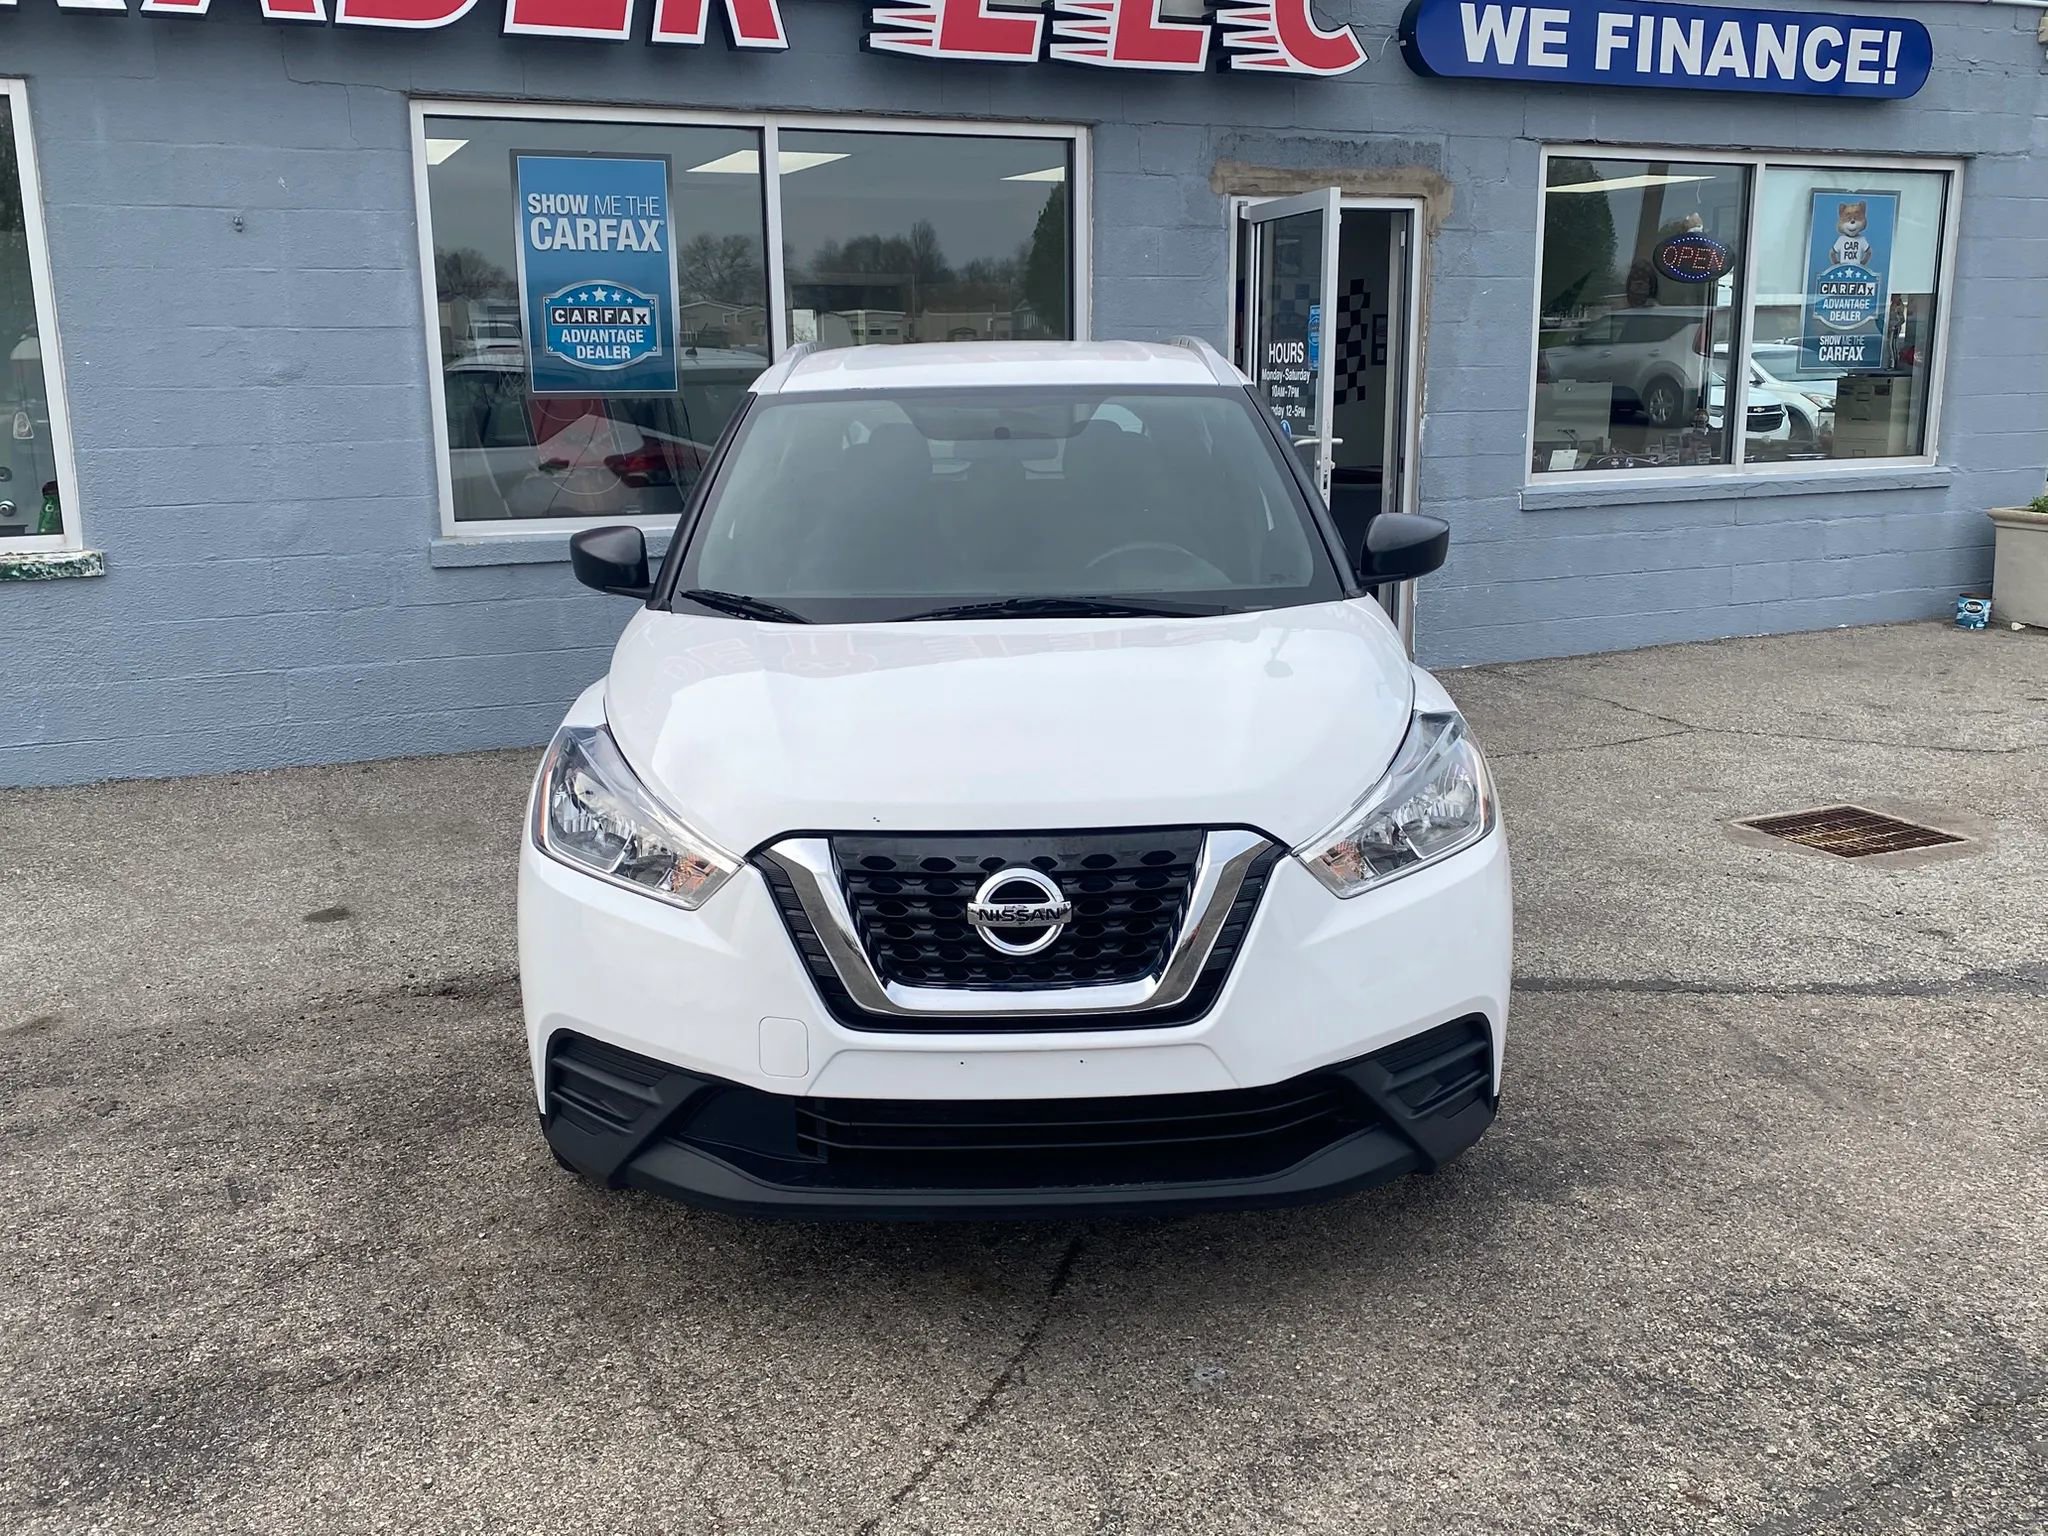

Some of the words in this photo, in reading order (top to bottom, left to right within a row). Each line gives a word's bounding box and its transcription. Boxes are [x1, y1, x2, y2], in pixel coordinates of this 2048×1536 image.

[1459, 2, 1570, 68] WE
[1595, 12, 1902, 85] FINANCE!
[527, 193, 588, 215] SHOW
[594, 195, 622, 216] ME
[626, 196, 660, 217] THE
[530, 216, 663, 252] CARFAX
[1843, 241, 1859, 251] CAR
[1663, 245, 1726, 271] OPEN
[1844, 251, 1858, 260] FOX
[1820, 283, 1875, 296] CARFAX
[1822, 298, 1870, 310] ADVANTAGE
[553, 308, 649, 325] CARFAX
[1829, 311, 1861, 322] DEALER
[561, 329, 644, 343] ADVANTAGE
[1819, 335, 1841, 346] SHOW
[1841, 336, 1852, 346] ME
[1852, 336, 1865, 346] THE
[576, 345, 631, 359] DEALER
[1268, 342, 1304, 363] HOURS
[1818, 346, 1866, 362] CARFAX
[1261, 368, 1311, 384] Monday-Saturday
[1286, 405, 1306, 418] 12-5PM
[978, 908, 1061, 922] NISSAN
